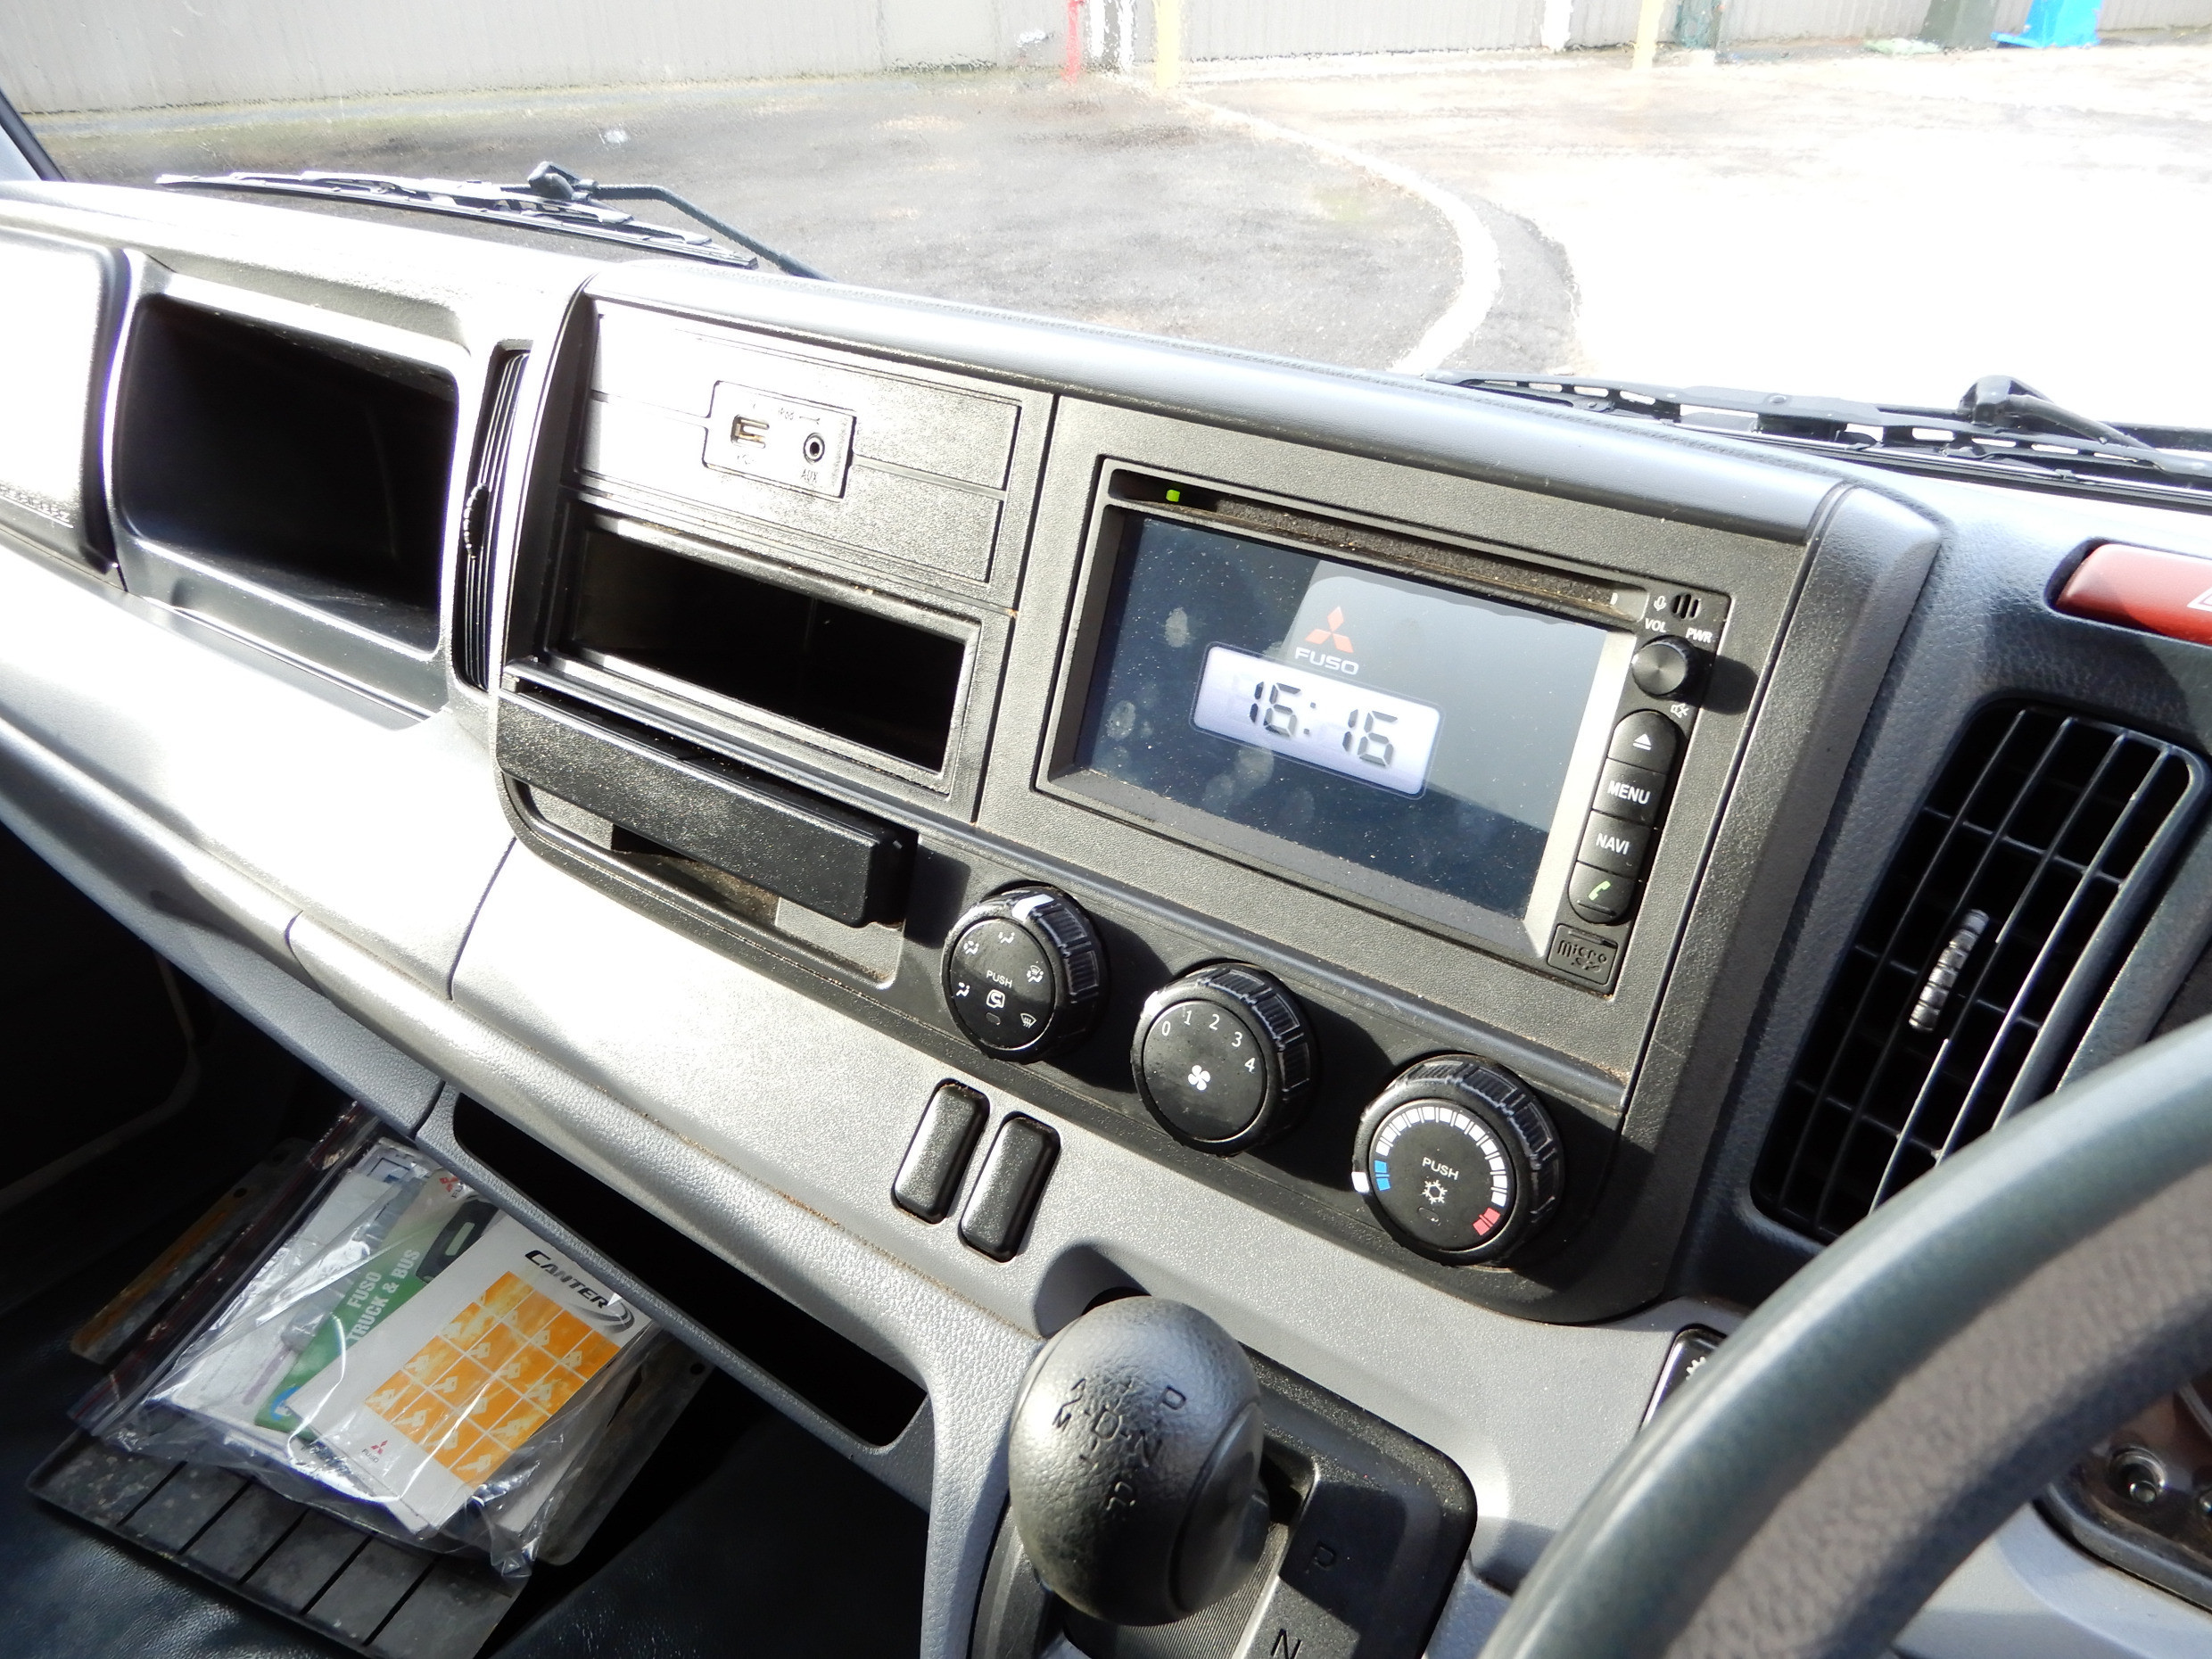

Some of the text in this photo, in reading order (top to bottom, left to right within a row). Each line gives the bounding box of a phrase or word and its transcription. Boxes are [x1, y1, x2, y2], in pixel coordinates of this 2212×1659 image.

[1644, 617, 1667, 633] VOL
[1685, 627, 1713, 644] PWR
[1294, 647, 1359, 675] FUSO
[1249, 681, 1399, 767] 16:16
[1606, 779, 1651, 805] MENU
[1595, 832, 1630, 856] NAVI
[1556, 939, 1608, 964] micro
[986, 969, 1013, 989] PUSH
[1161, 1010, 1257, 1073] 0 1 2 3 4
[1421, 1156, 1460, 1182] PUSH
[346, 1271, 383, 1309] FUSO
[524, 1250, 608, 1309] CANTER
[346, 1249, 421, 1341] TRUCK & BUS
[1270, 1628, 1304, 1659] N
